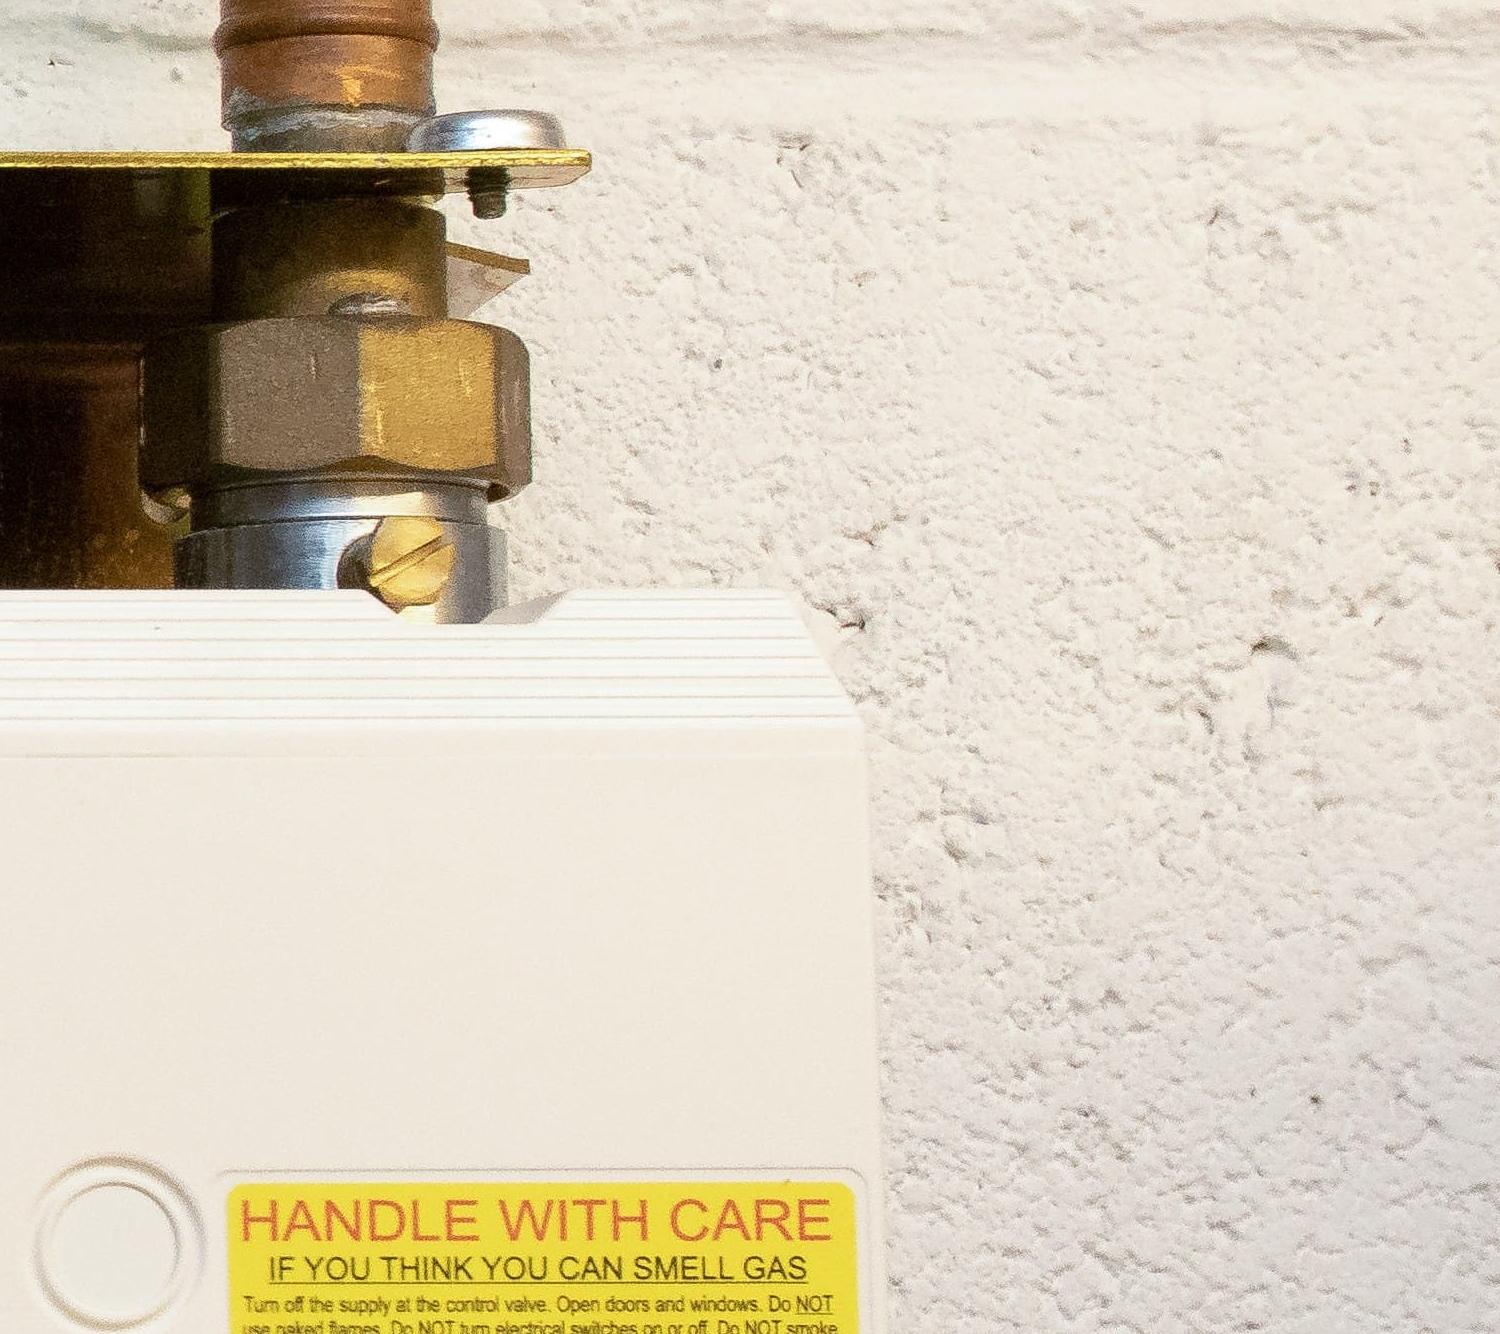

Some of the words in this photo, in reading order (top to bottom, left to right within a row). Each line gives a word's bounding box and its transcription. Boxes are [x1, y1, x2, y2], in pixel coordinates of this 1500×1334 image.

[241, 1198, 480, 1242] HANDLE
[498, 1198, 649, 1242] WITH
[670, 1198, 833, 1242] CARE
[269, 1255, 296, 1281] IF
[304, 1255, 371, 1281] YOU
[380, 1255, 474, 1281] THINK
[481, 1255, 548, 1281] YOU
[558, 1255, 624, 1281] CAN
[633, 1255, 735, 1281] SMELL
[743, 1255, 808, 1281] GAS
[243, 1295, 279, 1313] Turn
[284, 1295, 305, 1313] off
[309, 1295, 334, 1313] the
[339, 1295, 391, 1317] supply
[395, 1295, 411, 1313] at
[416, 1295, 440, 1313] the
[446, 1295, 500, 1313] control
[504, 1295, 550, 1313] valve.
[556, 1295, 599, 1317] Open
[605, 1295, 651, 1313] doors
[655, 1295, 685, 1313] and
[690, 1295, 762, 1313] windows.
[768, 1295, 791, 1313] Do
[795, 1295, 834, 1313] NOT
